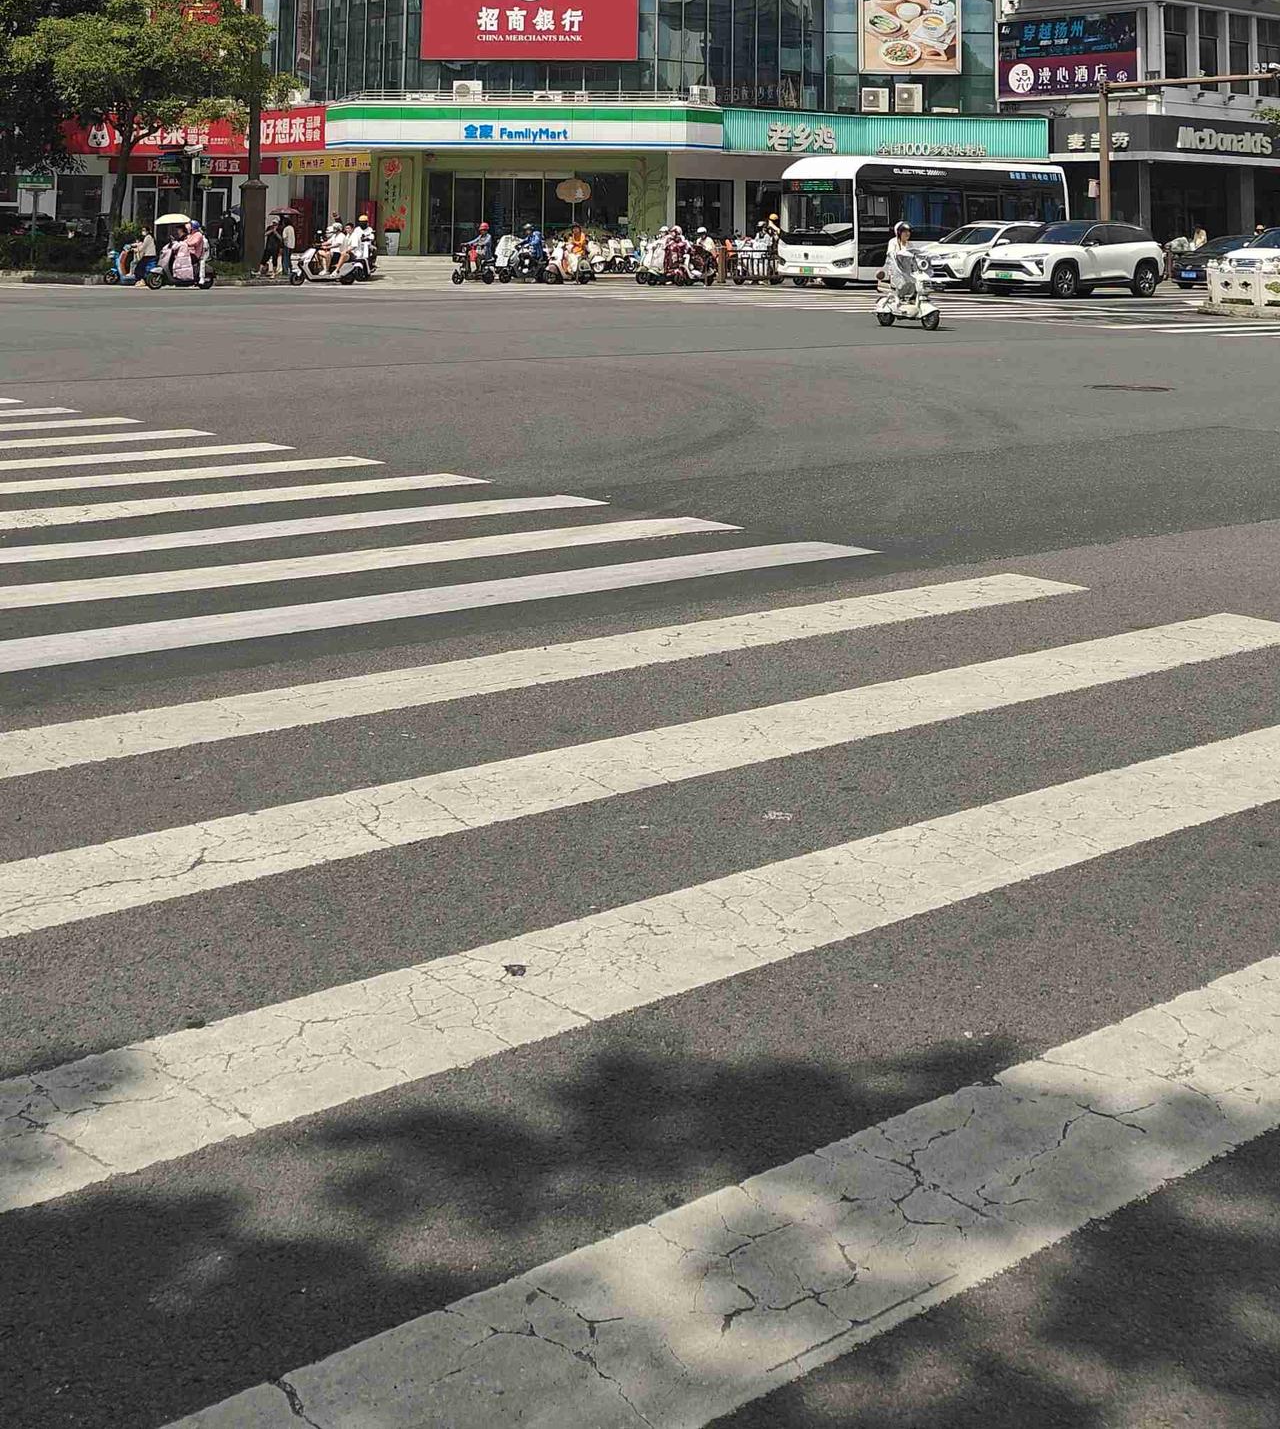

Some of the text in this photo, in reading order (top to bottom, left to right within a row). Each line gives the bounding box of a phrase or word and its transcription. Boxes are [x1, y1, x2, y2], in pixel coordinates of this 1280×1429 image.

[476, 34, 583, 42] CHINA MERCHANTS BANK
[1023, 19, 1084, 41] 穿越扬州
[1038, 63, 1108, 84] 漫心酒店
[260, 117, 305, 145] 好想来
[306, 128, 321, 142] 零食
[464, 124, 494, 139] 全家
[500, 127, 569, 142] FamilyMart
[767, 121, 837, 153] 老乡鸡
